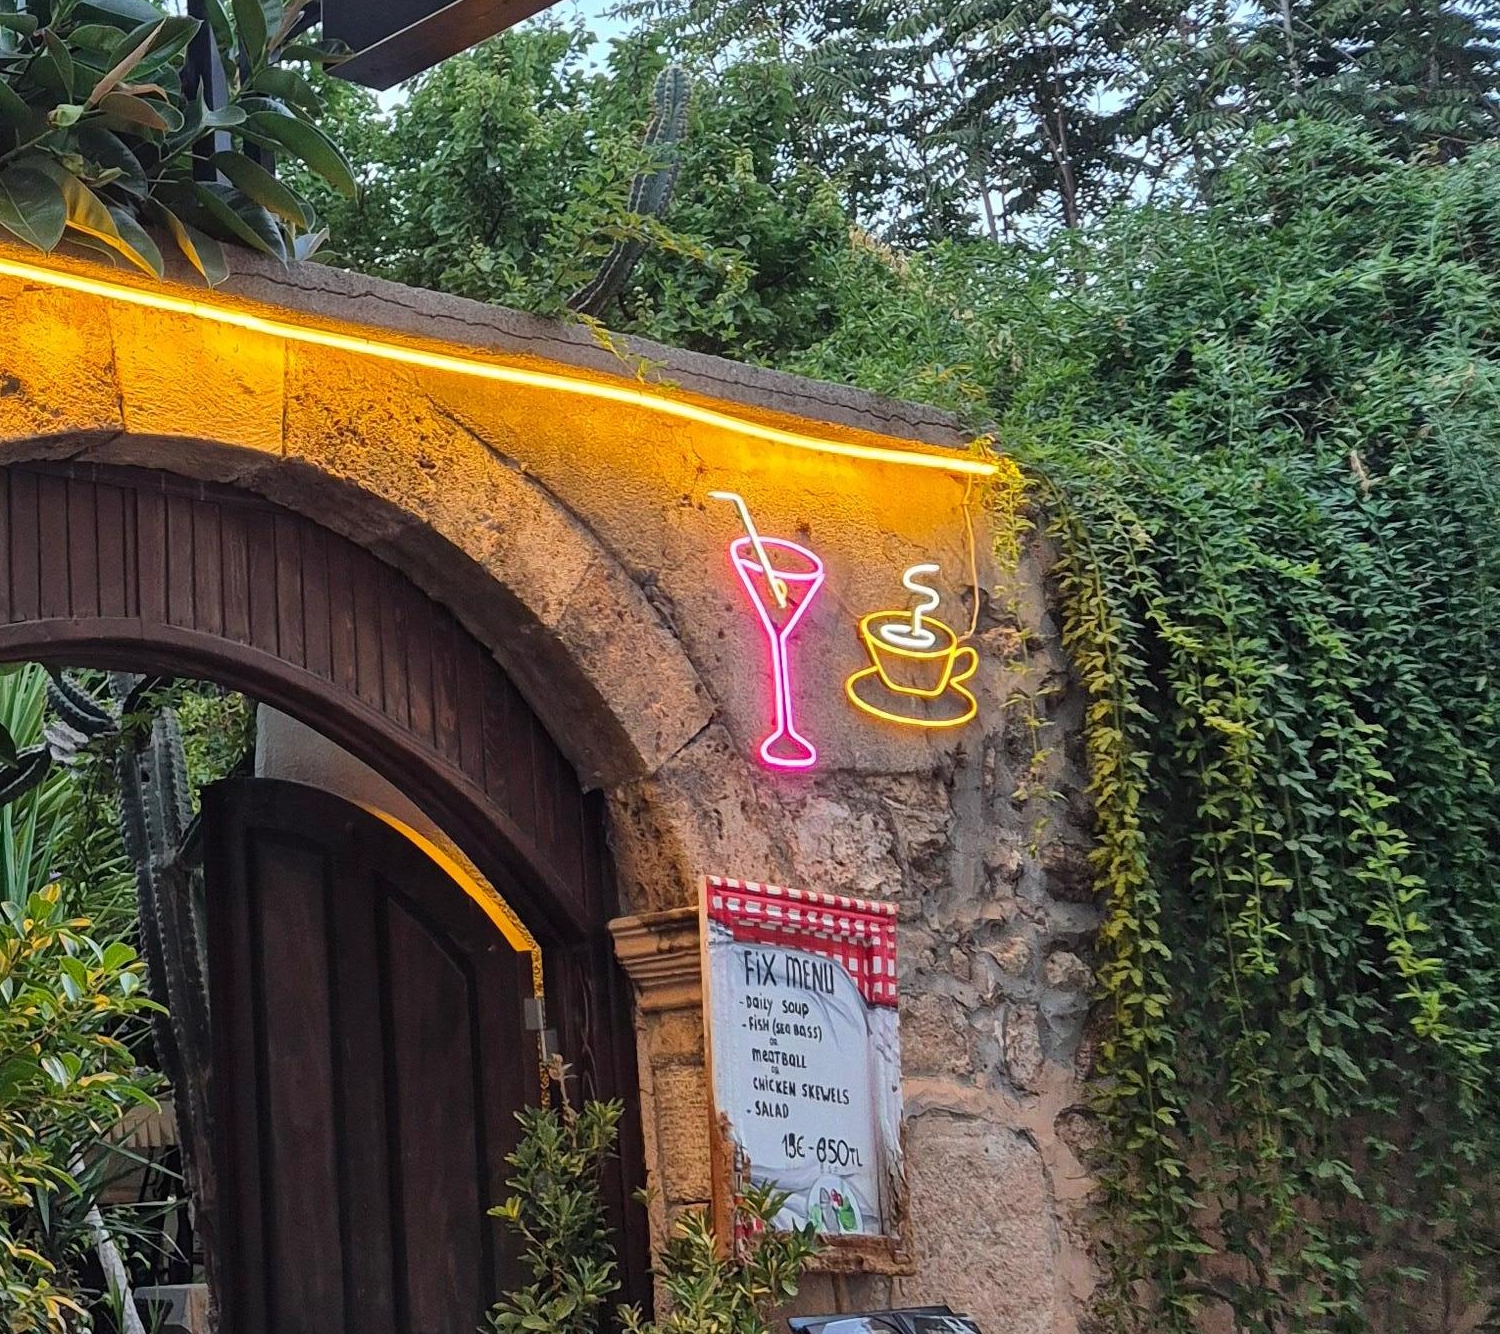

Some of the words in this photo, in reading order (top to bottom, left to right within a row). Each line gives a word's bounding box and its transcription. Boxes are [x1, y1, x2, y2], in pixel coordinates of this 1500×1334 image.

[785, 954, 835, 996] MENU
[782, 999, 810, 1019] SOUP
[755, 1100, 790, 1119] SALAD
